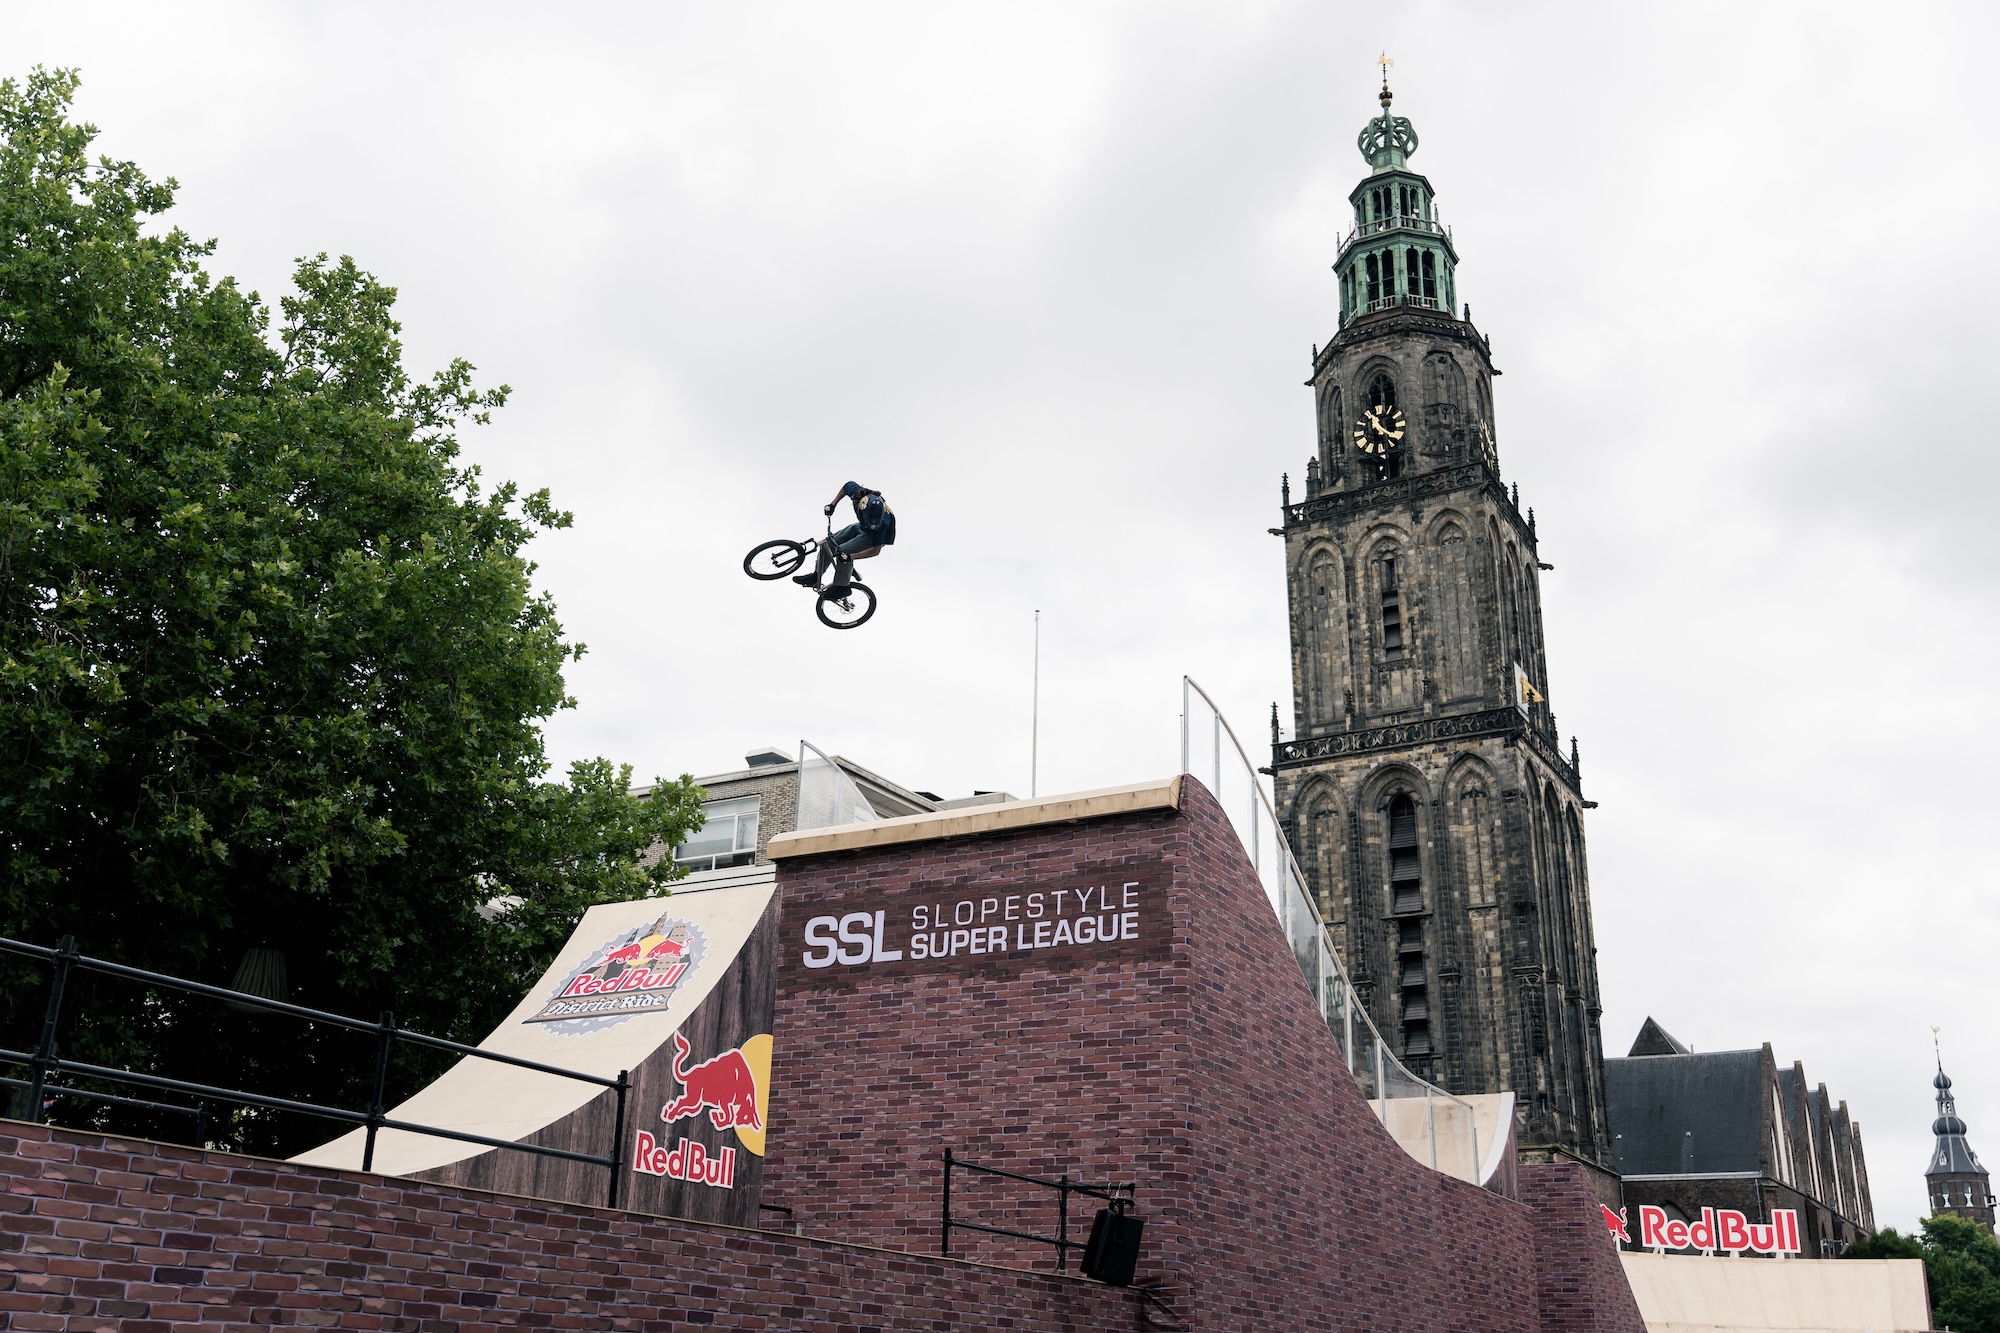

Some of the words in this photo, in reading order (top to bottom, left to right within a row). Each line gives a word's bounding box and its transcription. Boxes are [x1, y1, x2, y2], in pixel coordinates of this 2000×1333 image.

[912, 881, 1139, 930] SLOPESTYLE
[803, 910, 902, 969] SSL
[911, 925, 1007, 960] SUPER
[1017, 911, 1139, 950] LEAGUE
[564, 969, 629, 995] Red
[620, 963, 686, 991] Bull
[619, 993, 665, 1010] Ride
[635, 1131, 687, 1178] Red
[688, 1142, 735, 1187] Bull
[1641, 1207, 1715, 1249] Red
[1719, 1211, 1799, 1252] Bull
